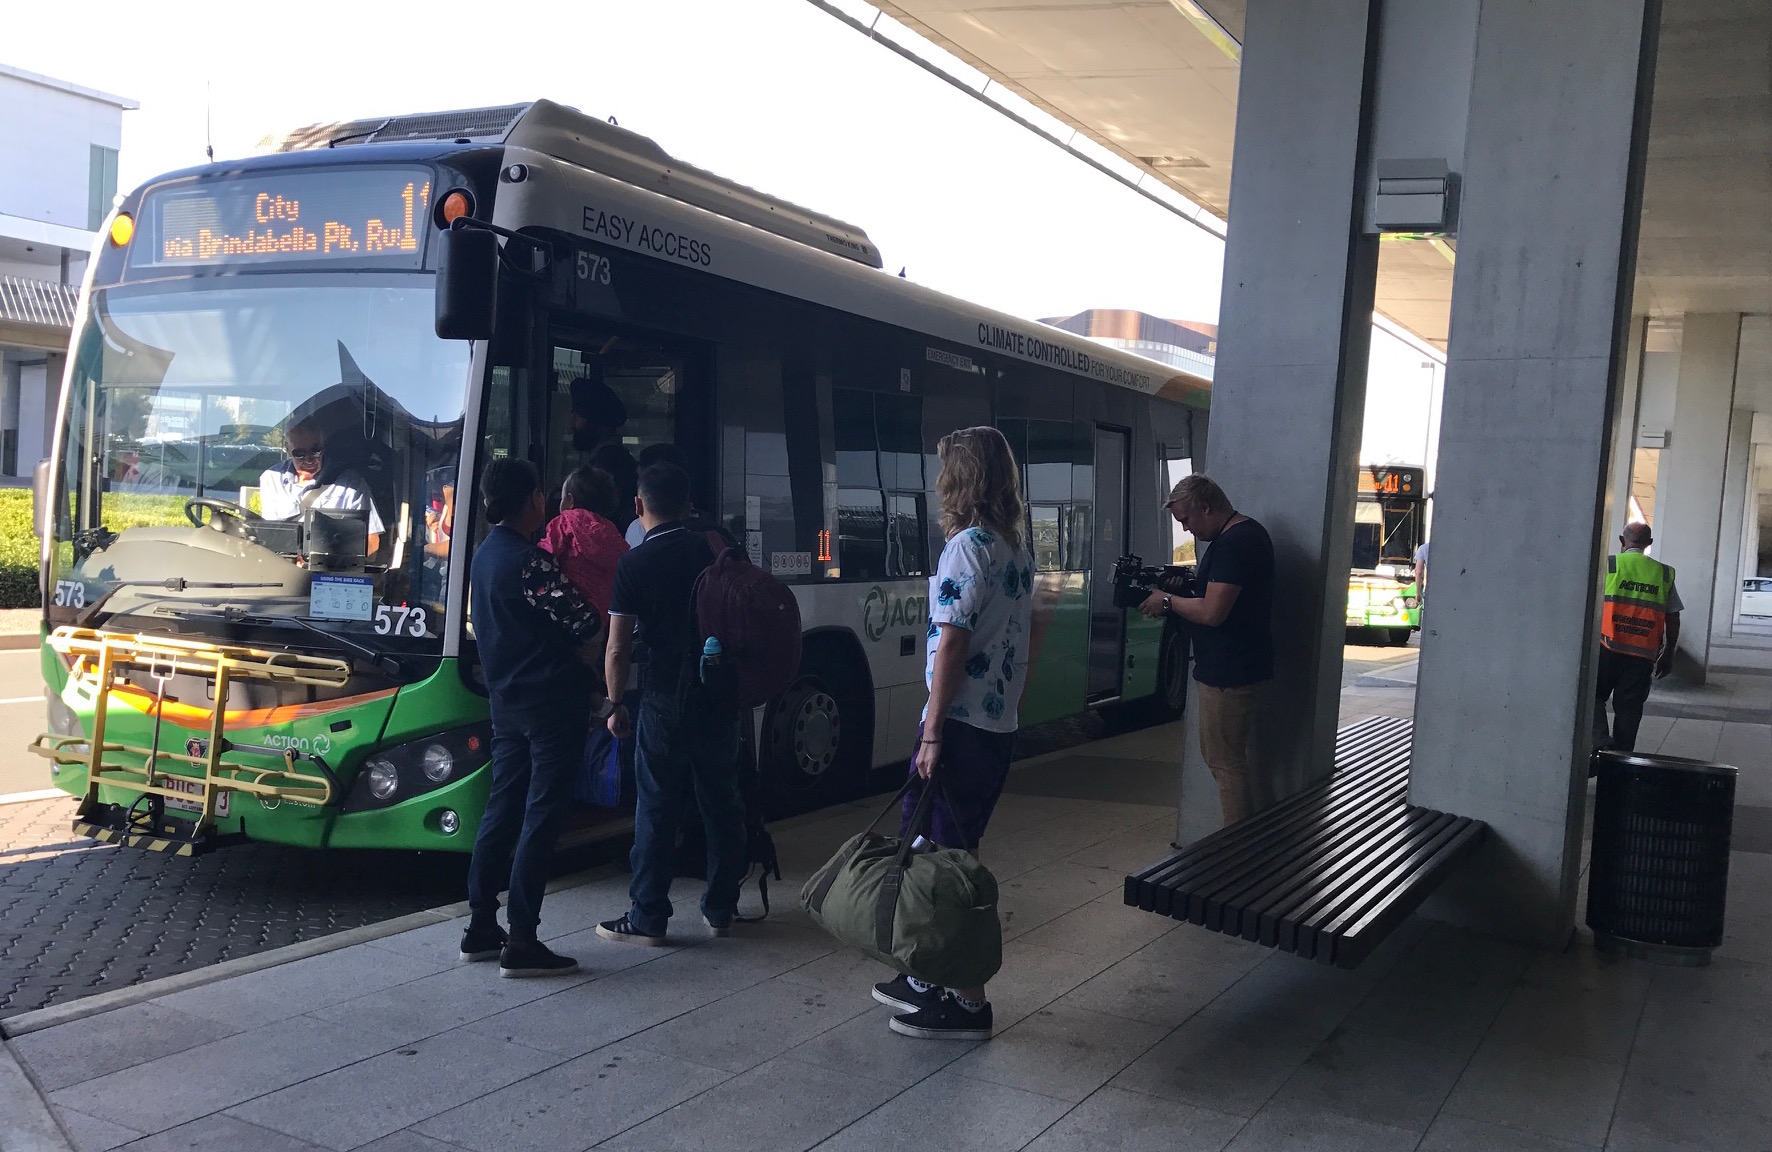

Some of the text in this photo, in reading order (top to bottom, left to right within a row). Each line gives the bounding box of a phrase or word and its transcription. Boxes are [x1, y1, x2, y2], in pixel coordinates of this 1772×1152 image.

[256, 192, 299, 223] City
[165, 237, 193, 258] via
[199, 227, 317, 259] Brindabella
[582, 205, 711, 266] EASY ACCESS
[577, 250, 612, 285] 573
[928, 348, 957, 366] EMERGENCY
[978, 322, 1151, 390] CLIMATE CONTROLLED FOR YOUR COMFORT
[817, 529, 832, 561] 11
[55, 580, 85, 609] 573
[1619, 580, 1659, 595] ACTION
[374, 605, 427, 638] 573
[890, 597, 928, 627] ACTI
[263, 734, 309, 750] ACTION
